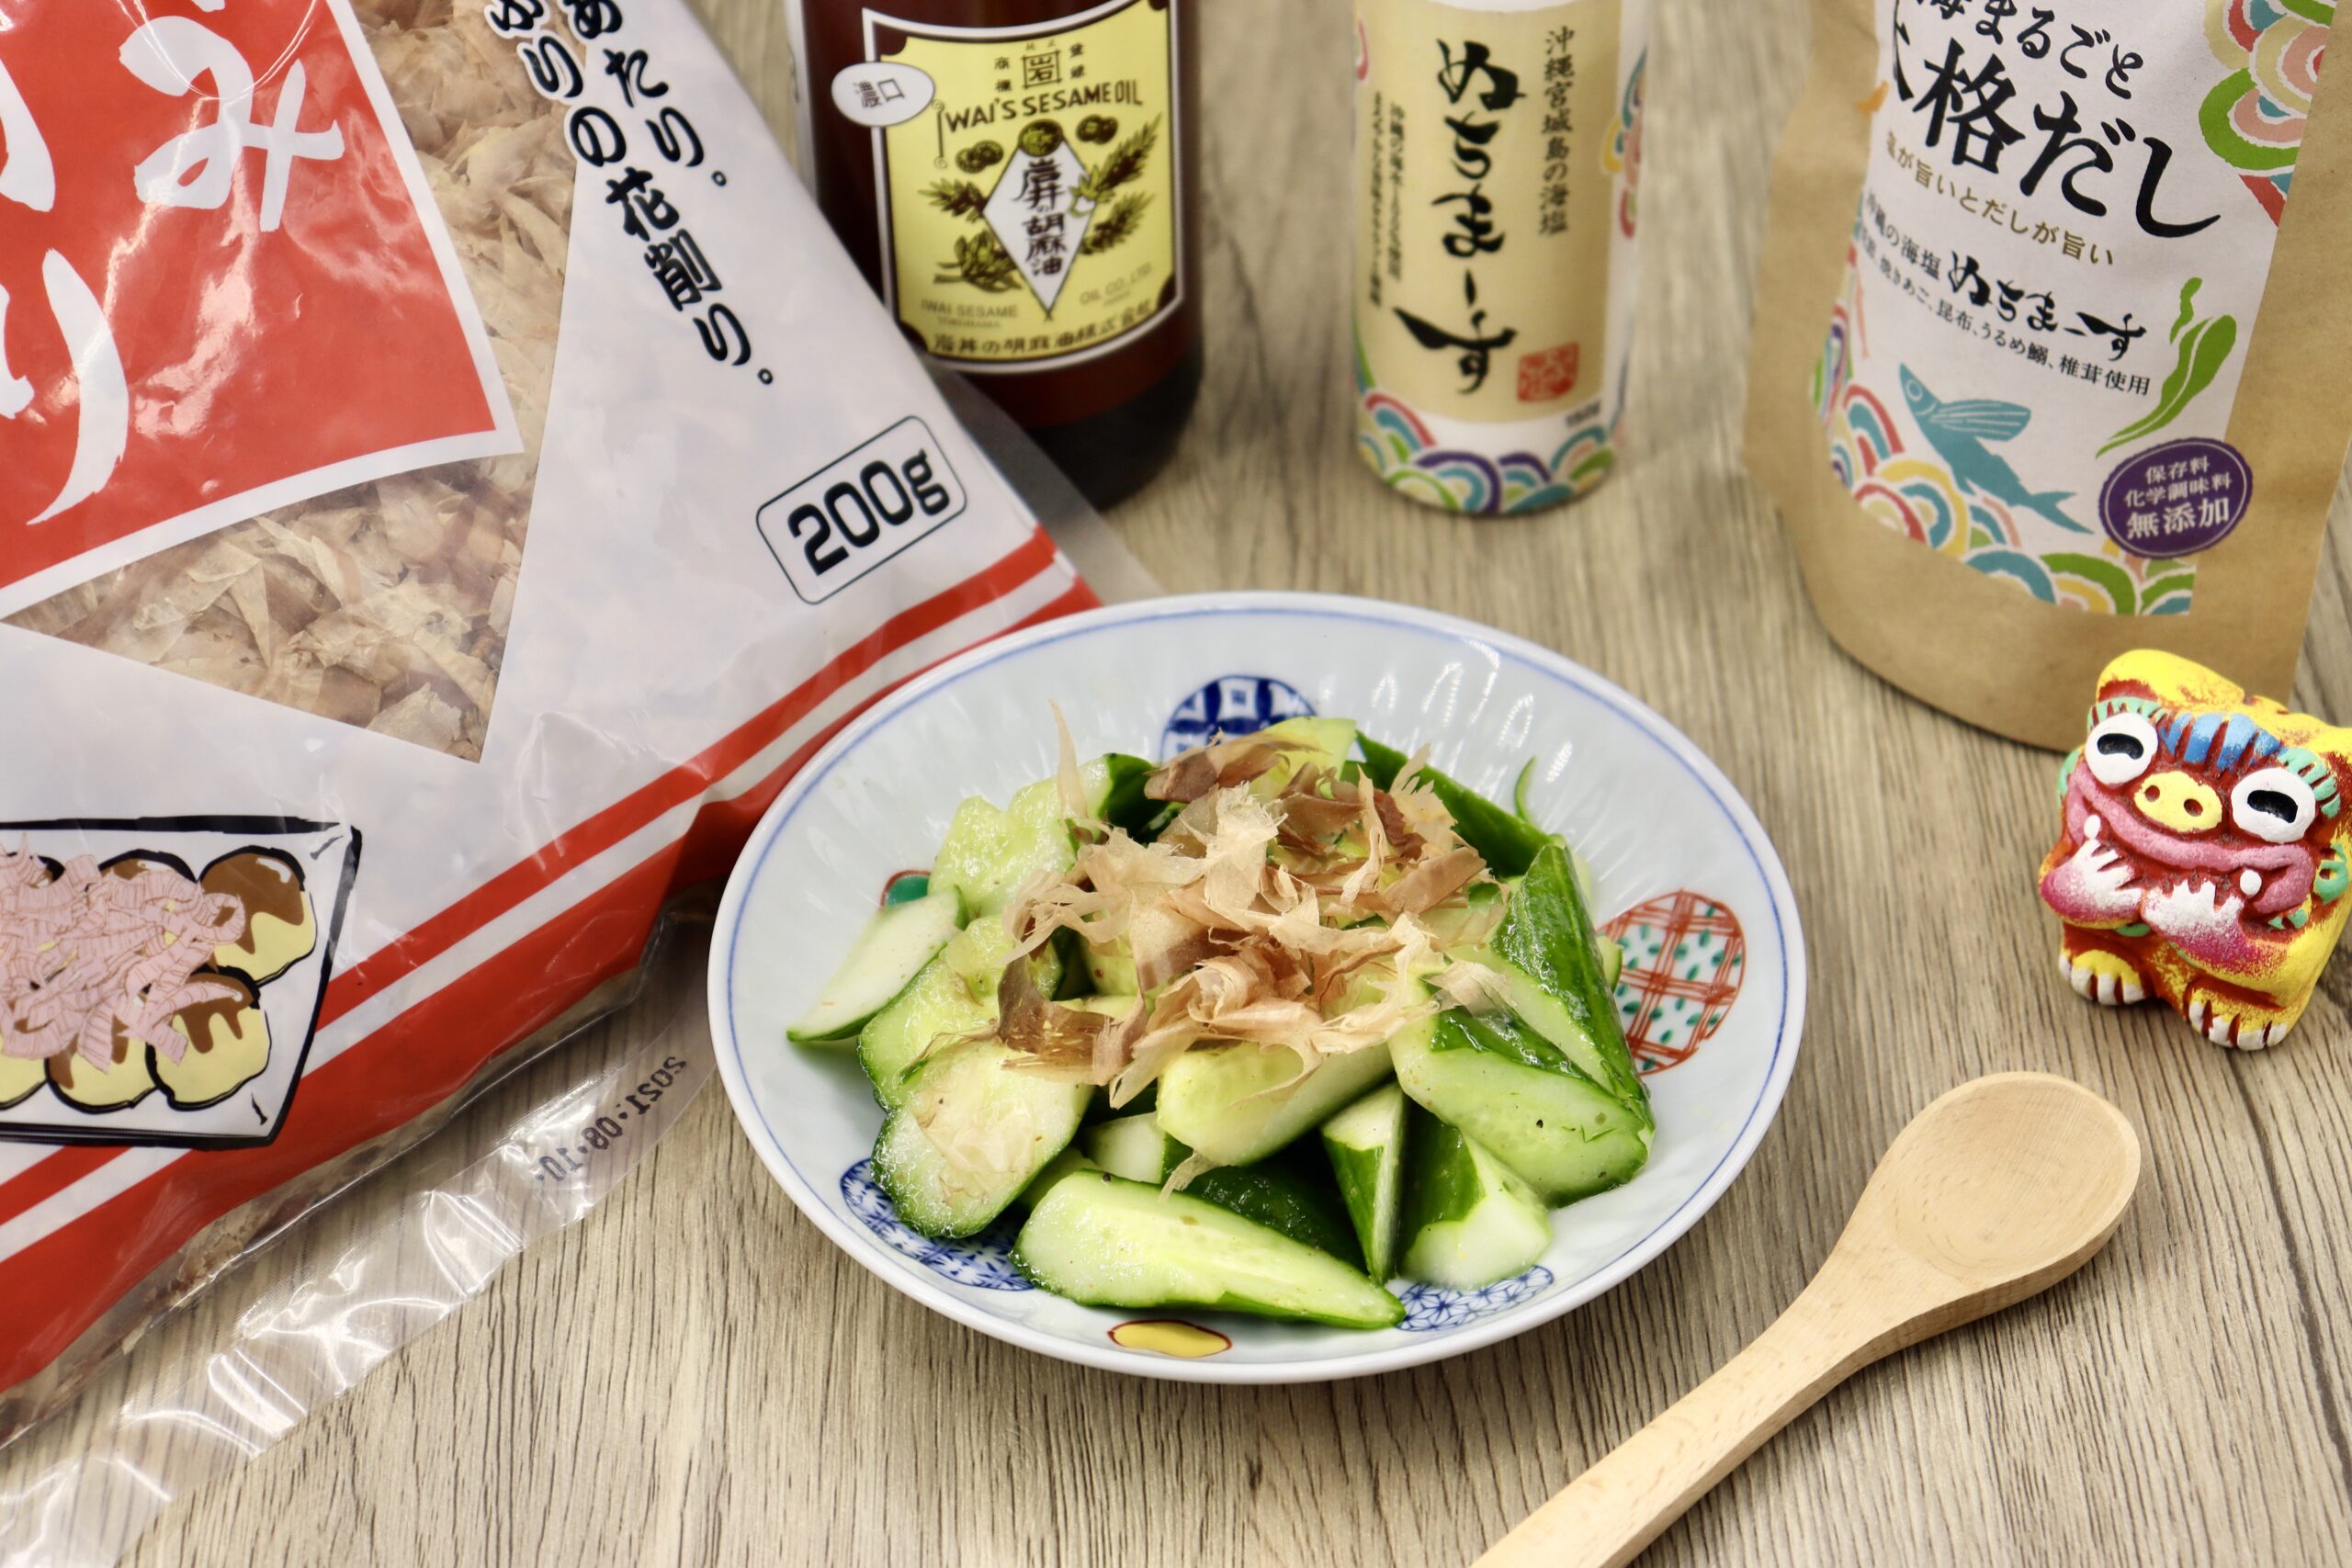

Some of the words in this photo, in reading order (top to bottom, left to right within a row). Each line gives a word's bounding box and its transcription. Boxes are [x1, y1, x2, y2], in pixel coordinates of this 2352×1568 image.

[1022, 81, 1111, 117] SESAME
[1114, 79, 1143, 107] OIL
[2145, 456, 2210, 484] 保存料
[2124, 472, 2233, 508] 化学調味料
[787, 448, 950, 577] 200g
[2126, 497, 2230, 540] 無添加
